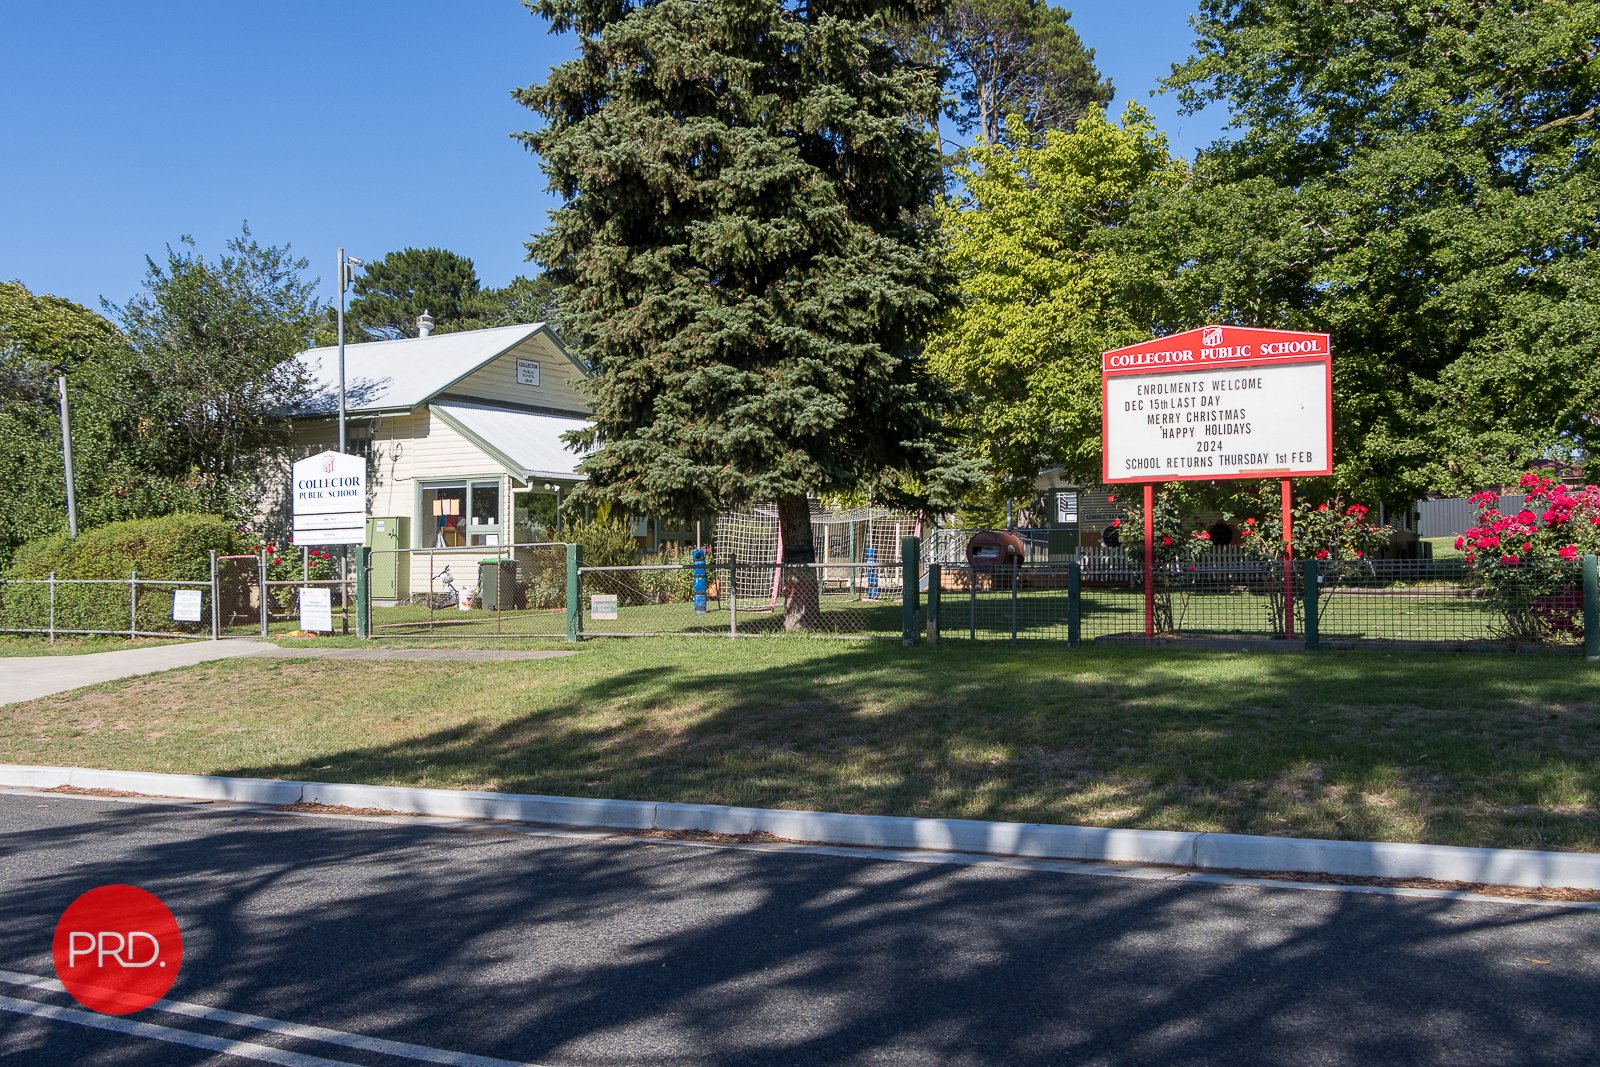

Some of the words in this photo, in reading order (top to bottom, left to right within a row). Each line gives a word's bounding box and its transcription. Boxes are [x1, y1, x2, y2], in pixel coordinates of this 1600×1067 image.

[1110, 349, 1194, 367] COLLECTOR
[1200, 345, 1251, 360] PUBLIC
[1260, 339, 1321, 355] SCHOOL
[1137, 381, 1204, 396] ENROLMENTS
[1212, 378, 1263, 391] WELCOME
[1124, 400, 1144, 412] DEC
[1150, 398, 1168, 410] 15th
[1170, 397, 1196, 409] LAST
[1201, 395, 1221, 407] DAY
[1147, 413, 1181, 425] MERRY
[1186, 409, 1246, 423] CHRISTMAS
[1161, 426, 1195, 439] HAPPY
[1205, 422, 1252, 436] HOLIDAYS
[1197, 440, 1223, 452] 2024
[1125, 457, 1160, 470] SCHOOL
[1166, 455, 1213, 468] RETURNS
[1219, 453, 1269, 466] THURSDAY
[1275, 452, 1287, 464] 1st
[1291, 451, 1313, 463] FEB
[298, 476, 360, 490] COLLECTOR
[299, 491, 324, 500] PUBLIC
[328, 489, 358, 498] SCHOOL
